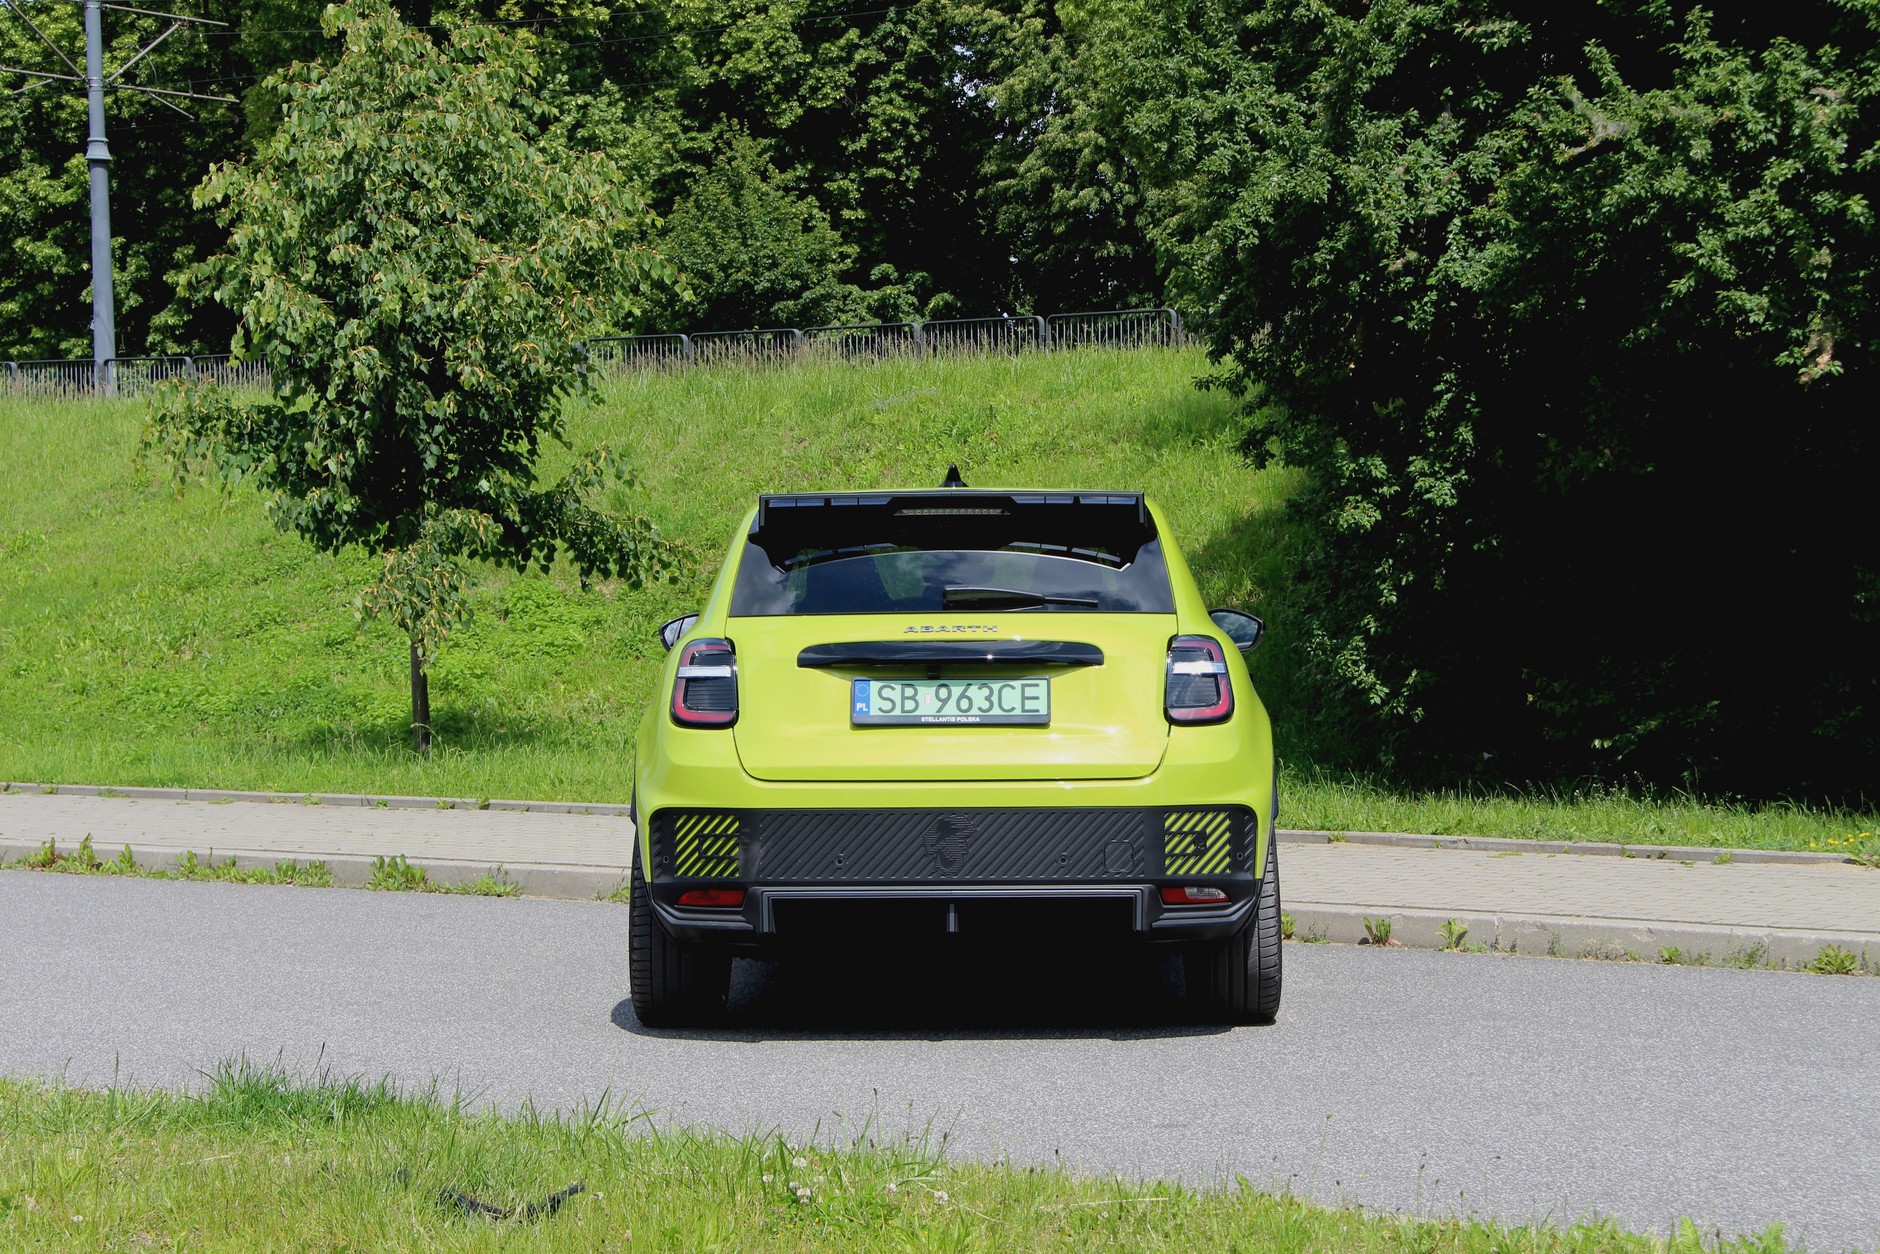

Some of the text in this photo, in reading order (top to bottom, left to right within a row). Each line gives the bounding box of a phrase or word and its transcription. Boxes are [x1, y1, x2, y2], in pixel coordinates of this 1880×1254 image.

[903, 625, 998, 633] ABARTH
[877, 683, 1041, 713] SB 963CE
[856, 702, 868, 712] PL
